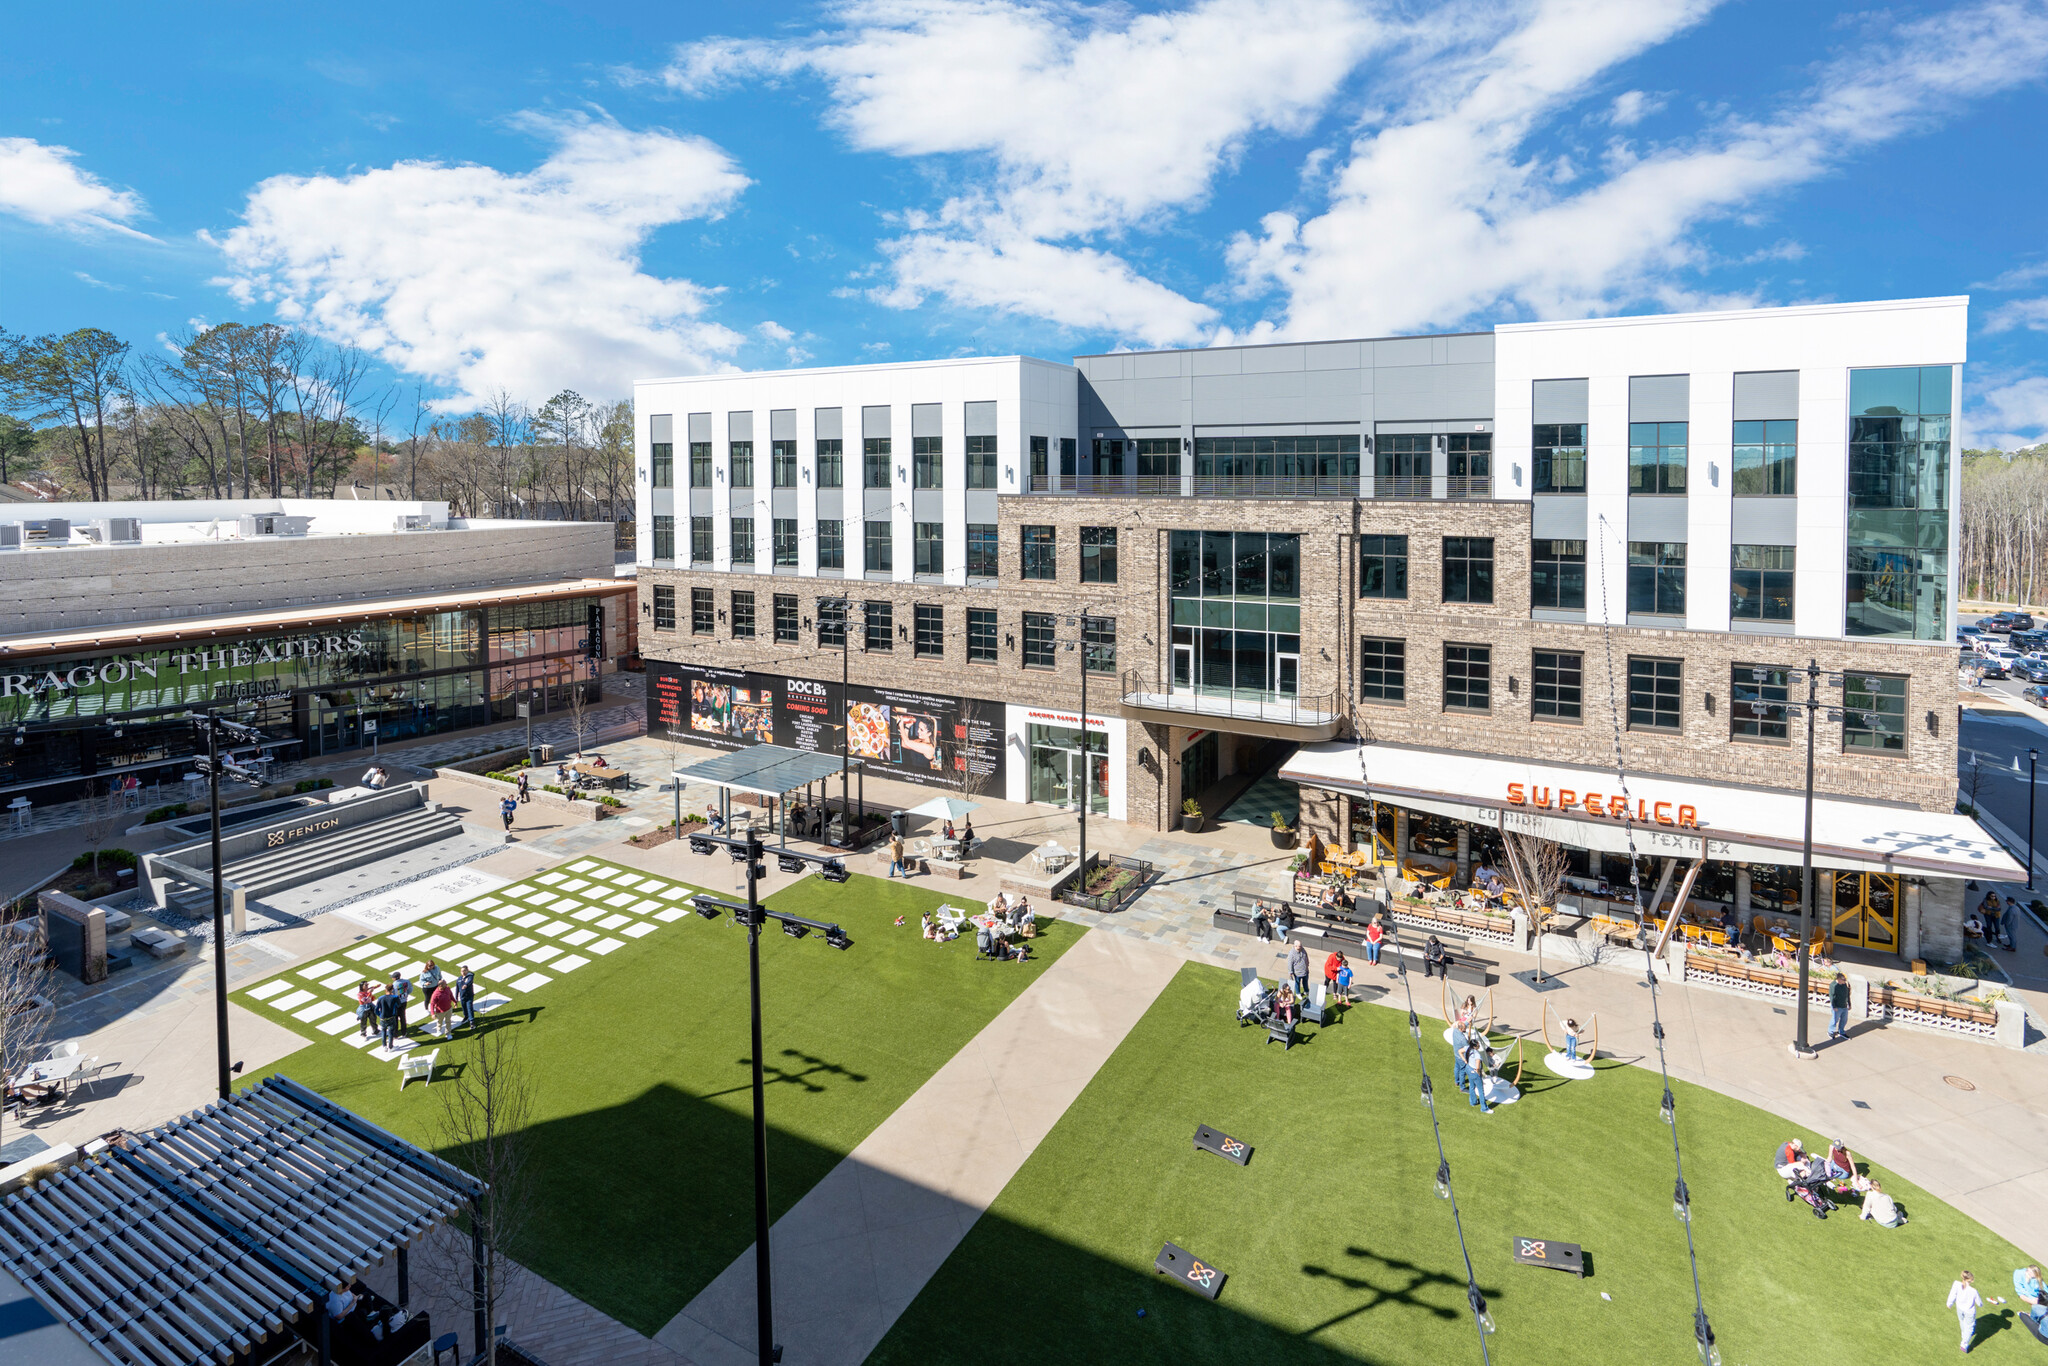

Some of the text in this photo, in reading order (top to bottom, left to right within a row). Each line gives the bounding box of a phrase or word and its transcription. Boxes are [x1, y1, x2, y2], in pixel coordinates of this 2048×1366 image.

[171, 633, 362, 674] THEATERS
[232, 679, 280, 698] AGENCY
[264, 690, 291, 702] social
[788, 680, 812, 694] DOC
[786, 703, 828, 715] COMING SOON
[1507, 782, 1697, 828] SUPERICA
[288, 818, 339, 839] FENTON
[1649, 832, 1730, 854] TEX MEX
